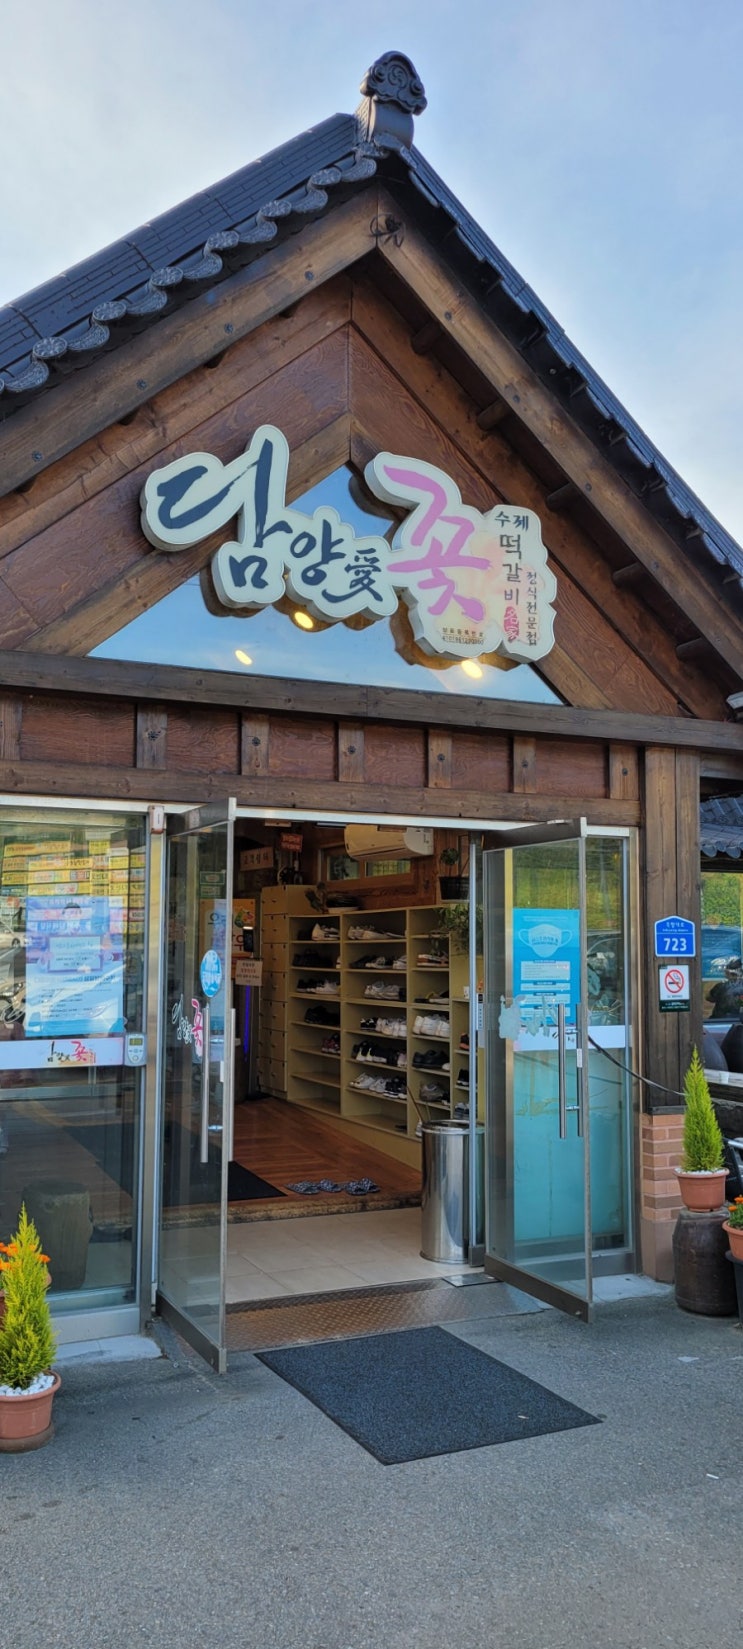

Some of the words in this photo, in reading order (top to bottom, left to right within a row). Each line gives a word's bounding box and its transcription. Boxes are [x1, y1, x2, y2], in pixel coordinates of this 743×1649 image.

[494, 510, 529, 532] 수제
[499, 534, 523, 606] 떡갈비
[525, 571, 538, 647] 정식전문점
[663, 937, 687, 952] 723
